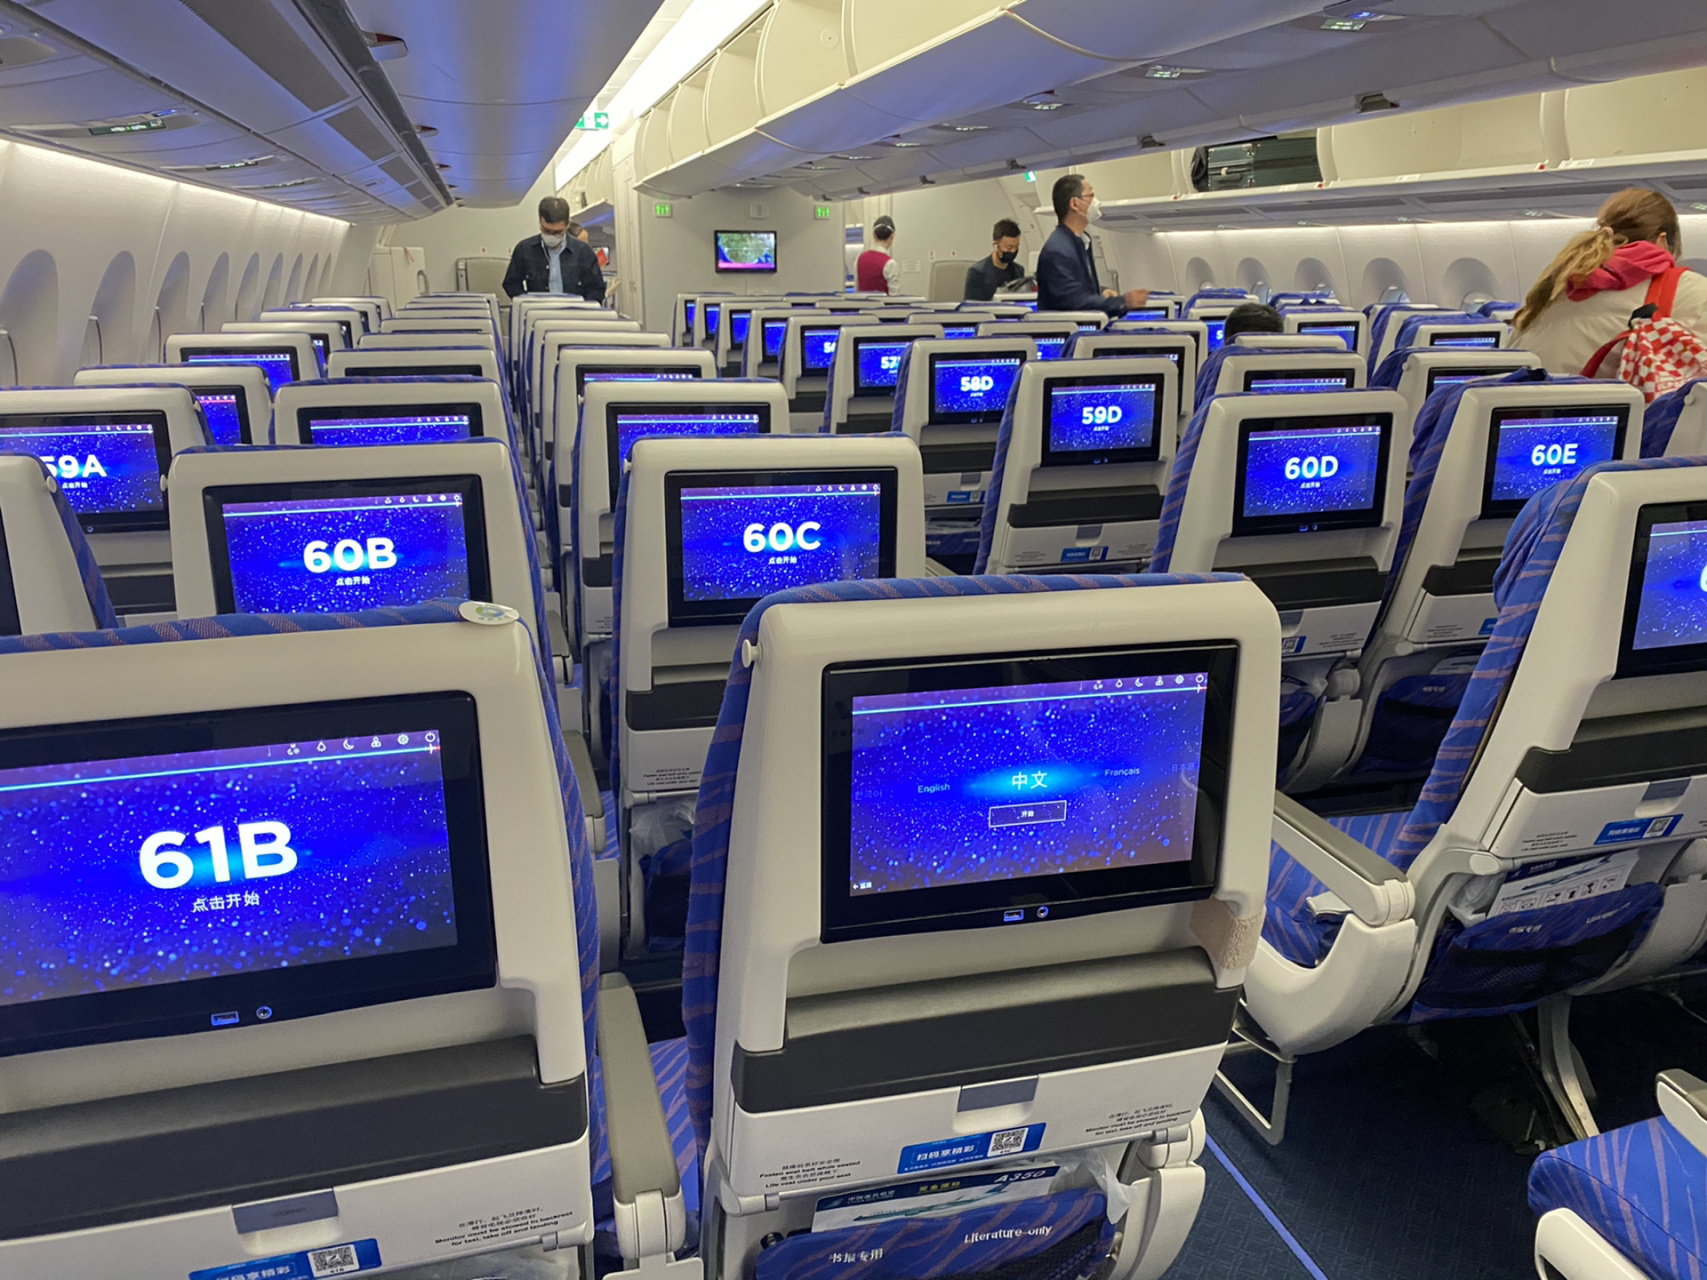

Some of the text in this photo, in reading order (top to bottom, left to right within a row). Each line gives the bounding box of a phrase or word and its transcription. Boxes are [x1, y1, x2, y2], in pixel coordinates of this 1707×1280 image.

[881, 356, 901, 369] 57
[960, 376, 994, 391] 58D
[1082, 406, 1122, 425] 59D
[1531, 443, 1579, 466] 60E
[1285, 455, 1339, 480] 60D
[743, 521, 821, 553] 60C
[303, 537, 397, 573] 60B
[1011, 770, 1048, 790] 中文
[1105, 767, 1140, 777] Français
[917, 783, 950, 794] English
[139, 821, 298, 889] 61B
[192, 891, 260, 913] 点击开始
[917, 1144, 975, 1161] 扫码享精彩
[994, 1170, 1046, 1183] A350
[435, 1233, 465, 1244] Monitor
[467, 1230, 488, 1238] must
[501, 1221, 529, 1231] stowed
[540, 1211, 573, 1223] backrest
[513, 1226, 528, 1234] and
[530, 1220, 559, 1231] landing
[964, 1228, 1022, 1243] Literature
[829, 1248, 884, 1264] 书报专用
